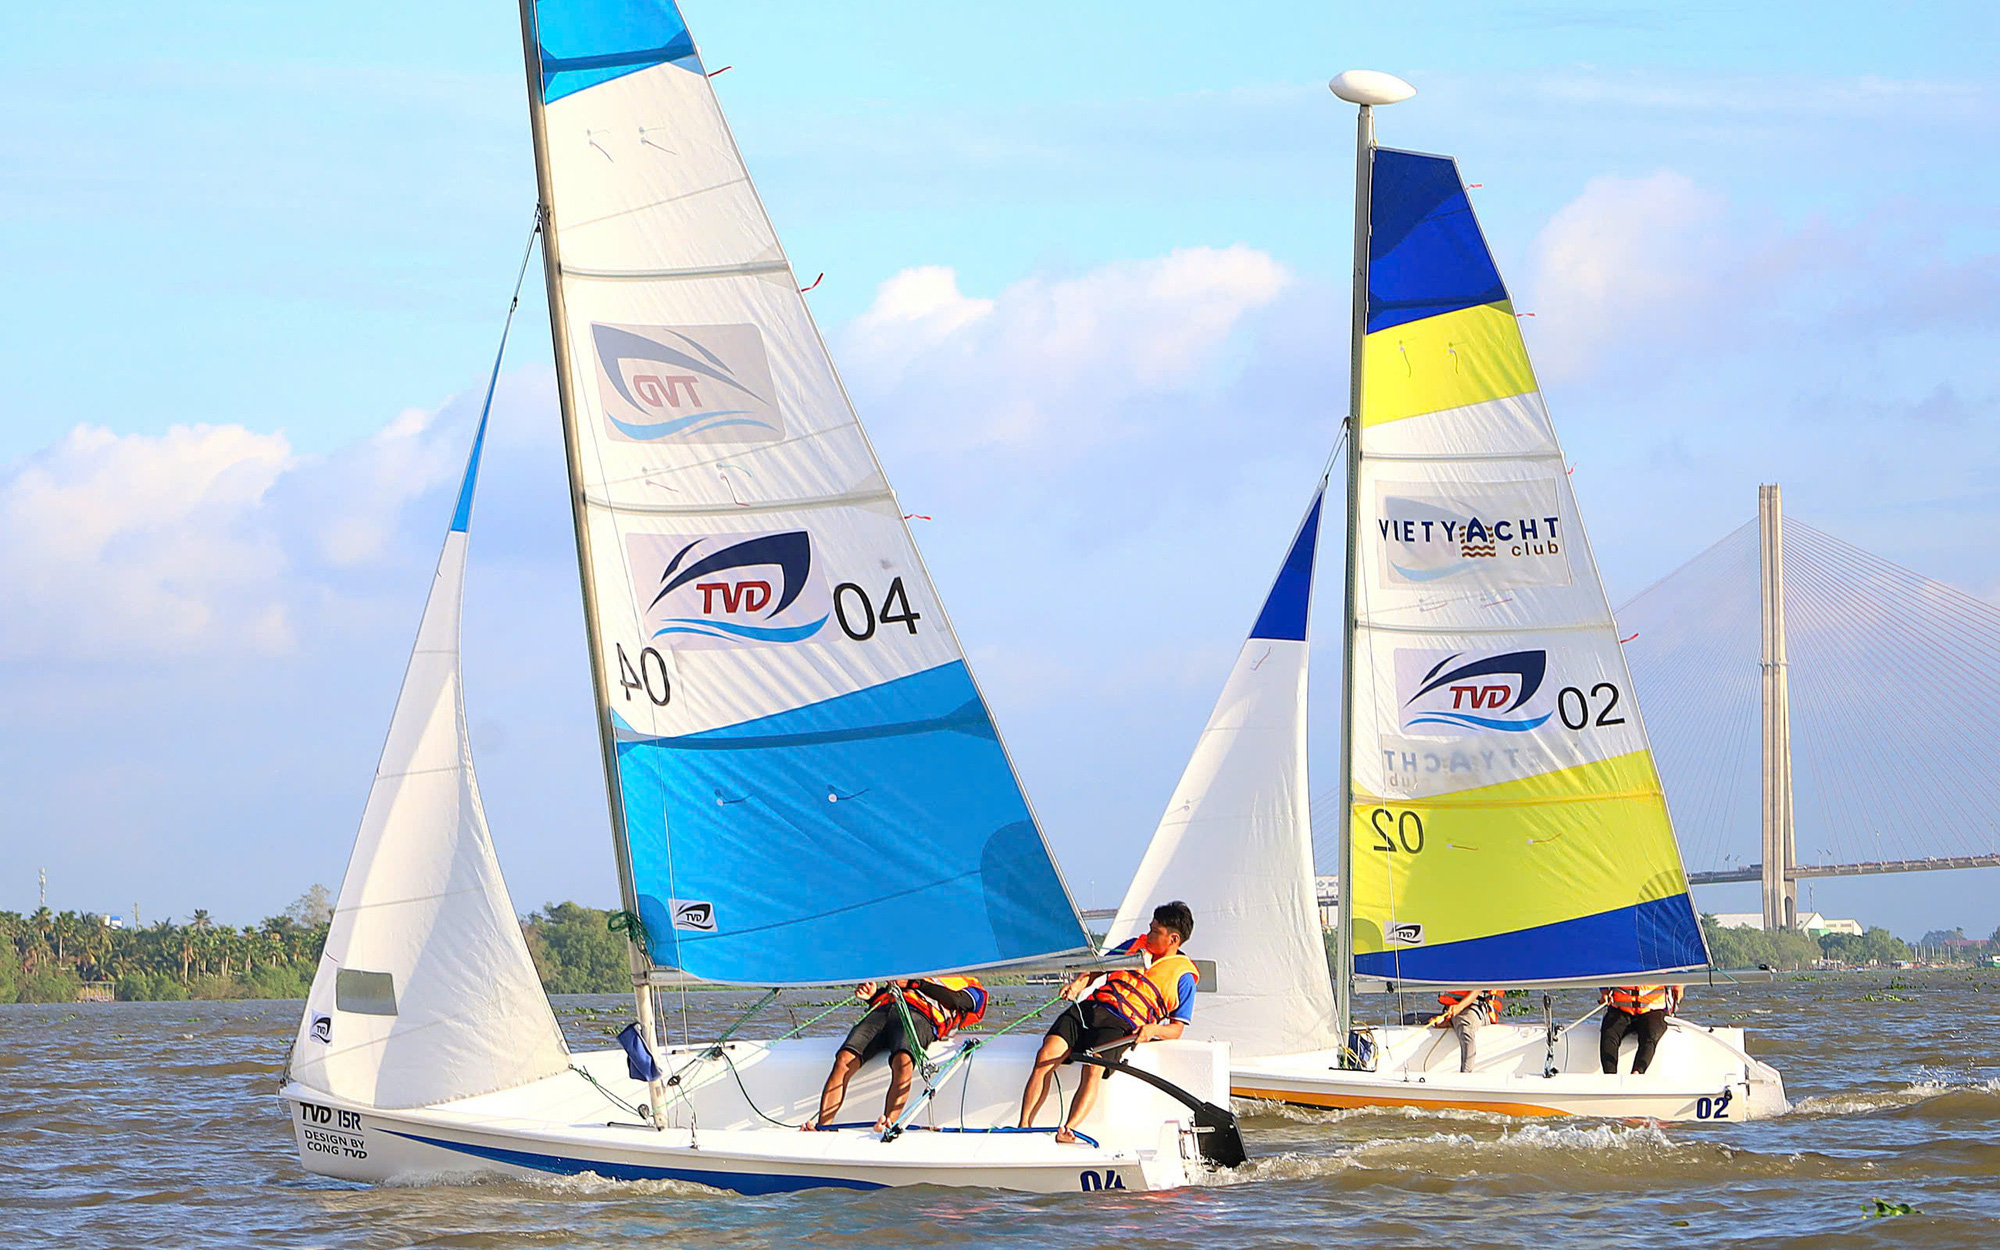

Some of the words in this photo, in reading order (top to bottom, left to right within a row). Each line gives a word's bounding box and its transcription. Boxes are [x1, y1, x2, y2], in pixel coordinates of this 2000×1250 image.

[1511, 540, 1559, 557] club
[696, 581, 772, 614] TVD
[832, 576, 921, 642] 04
[1448, 685, 1512, 710] TVD
[1557, 682, 1625, 730] 02
[686, 913, 702, 922] TVD
[300, 1102, 331, 1124] TVD
[338, 1109, 362, 1131] 15R
[1696, 1097, 1729, 1119] 02
[304, 1129, 348, 1146] DESIGN
[350, 1138, 365, 1149] BY
[307, 1141, 340, 1155] CONG
[343, 1147, 368, 1159] TVD
[1080, 1170, 1126, 1192] 04
